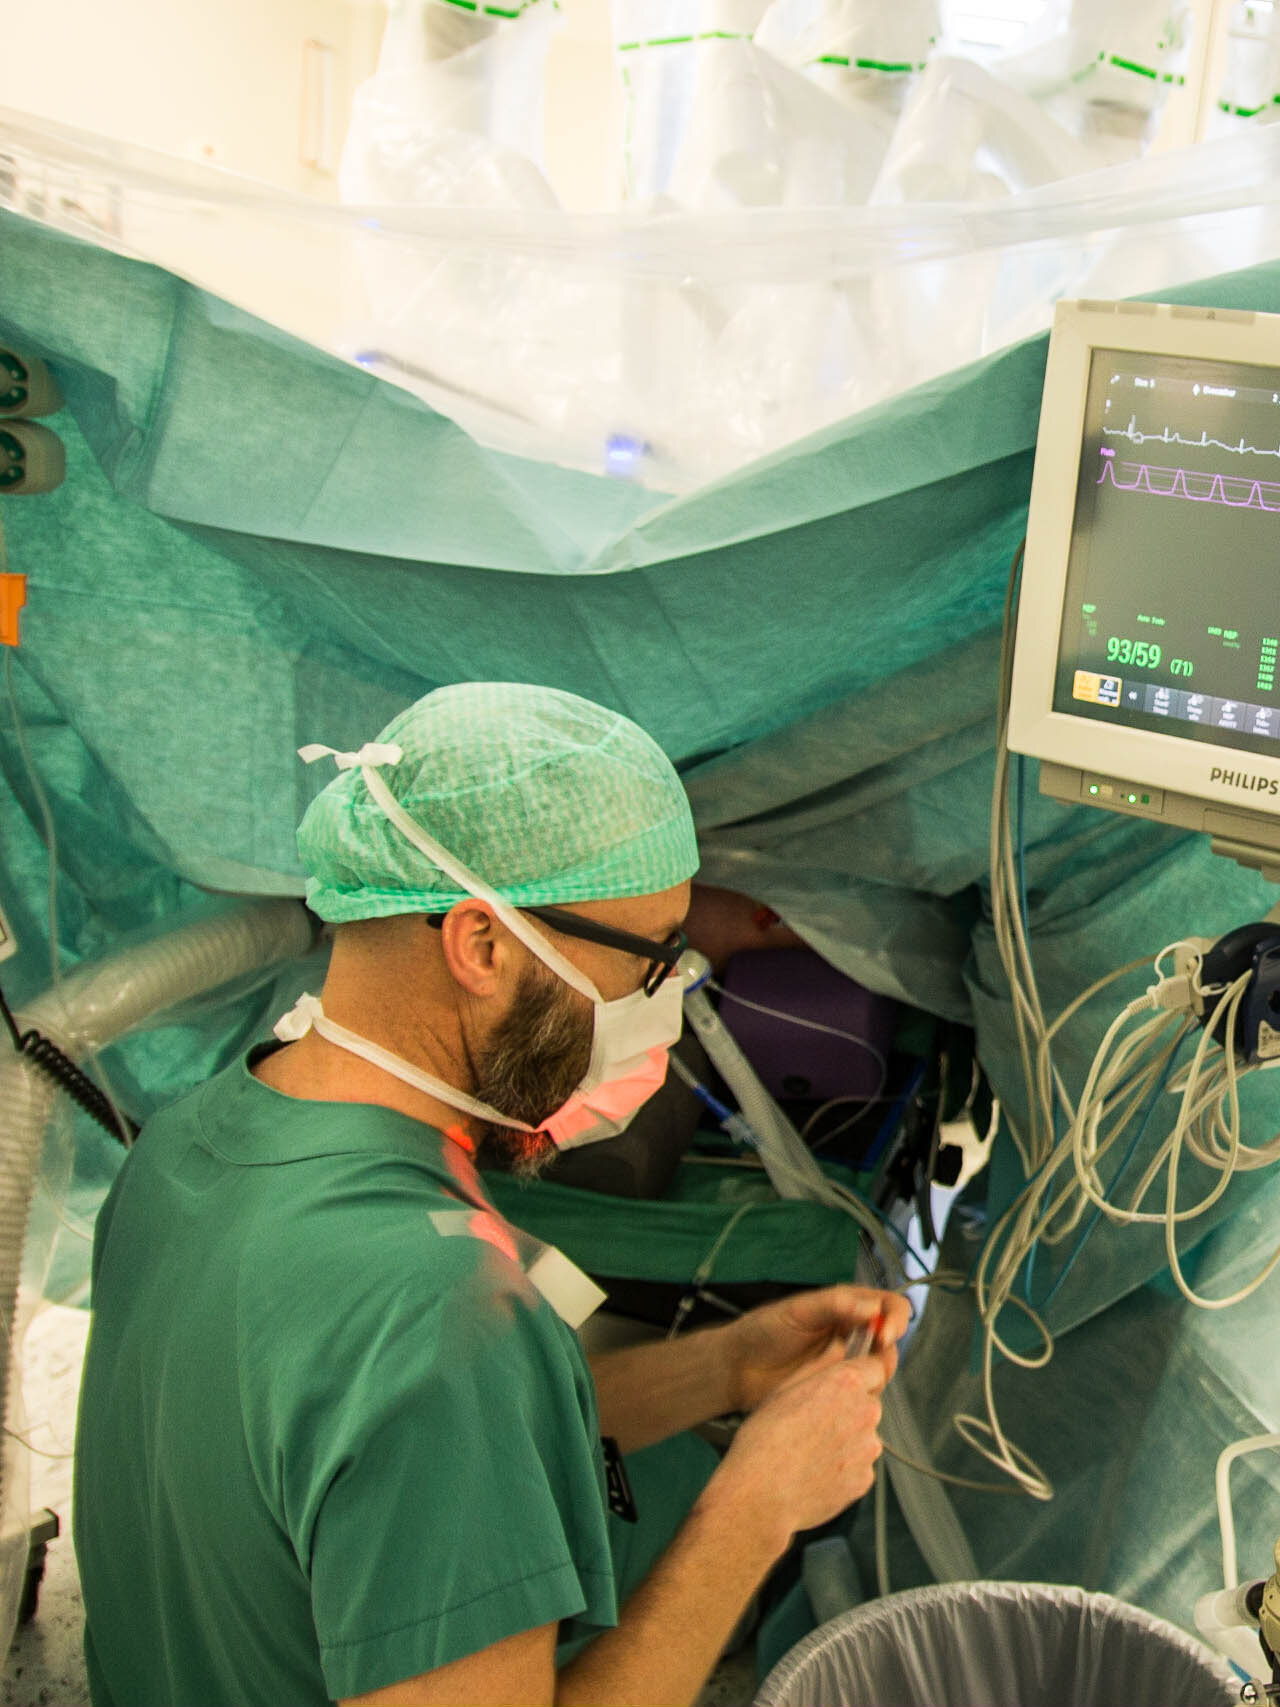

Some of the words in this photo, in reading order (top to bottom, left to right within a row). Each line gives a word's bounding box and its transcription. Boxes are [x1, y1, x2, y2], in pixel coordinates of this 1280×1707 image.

[1107, 636, 1162, 669] 93/59
[1170, 658, 1194, 677] (71)
[1210, 767, 1279, 795] PHILIPS
